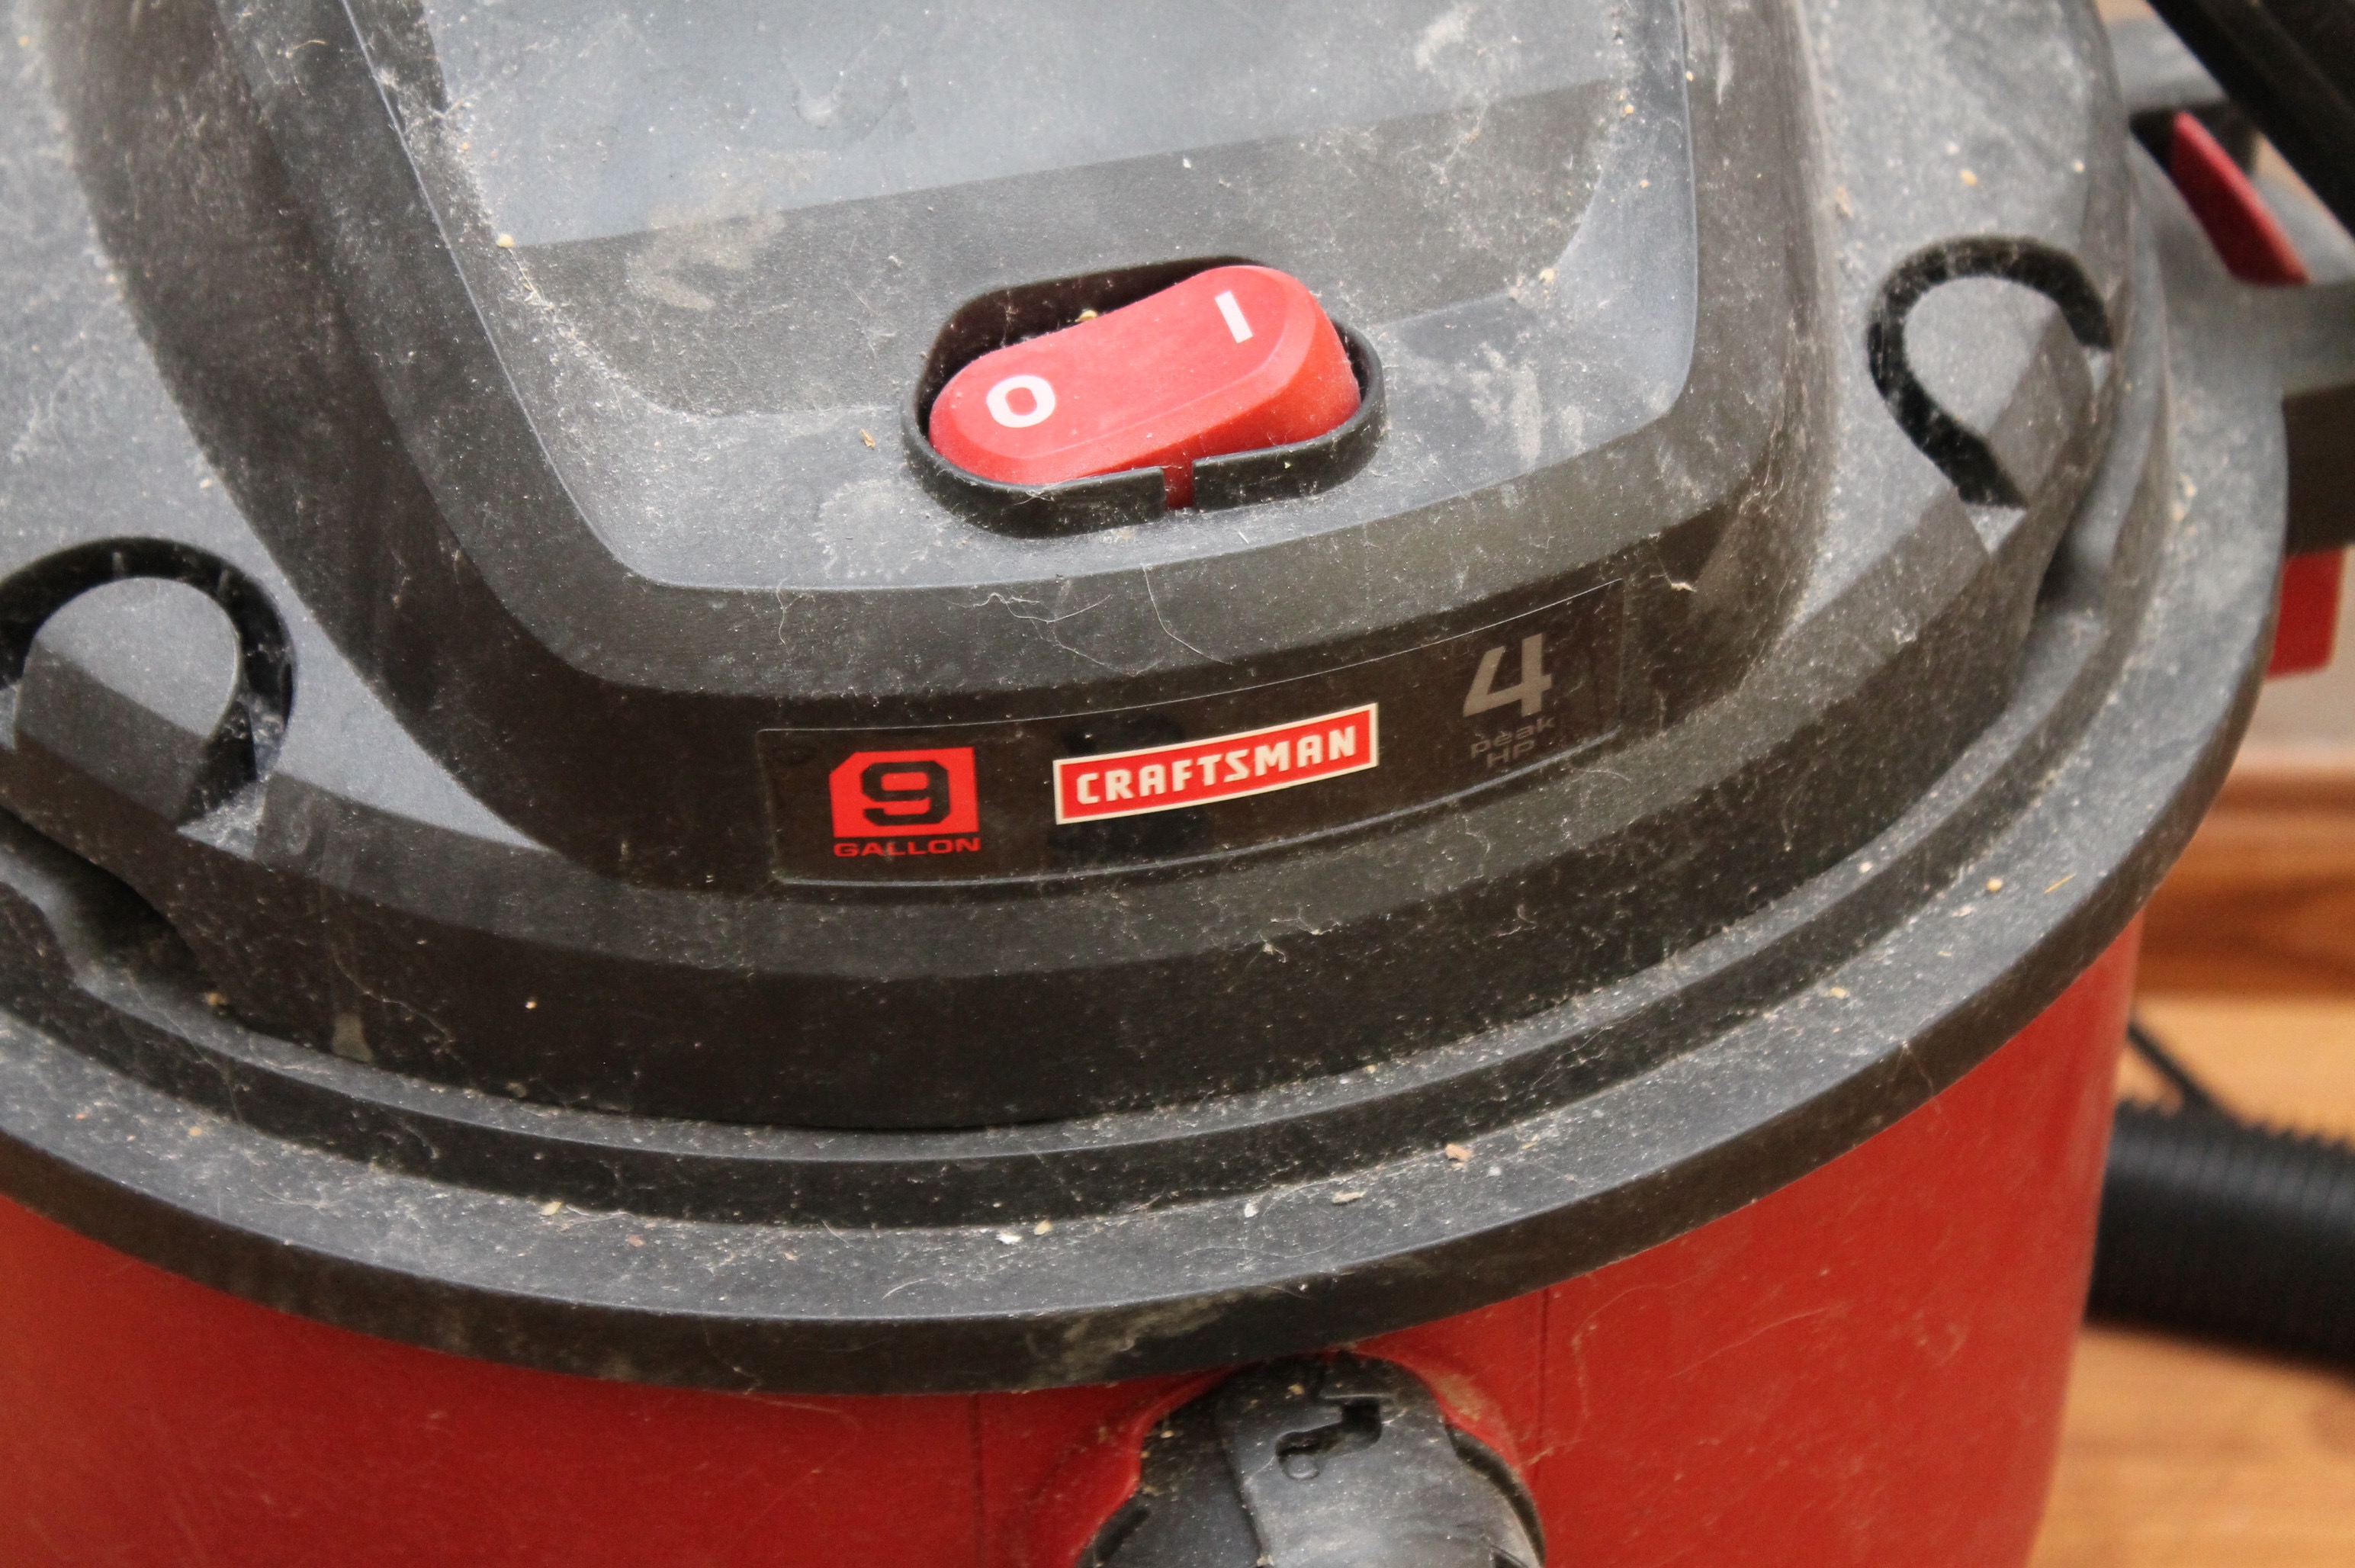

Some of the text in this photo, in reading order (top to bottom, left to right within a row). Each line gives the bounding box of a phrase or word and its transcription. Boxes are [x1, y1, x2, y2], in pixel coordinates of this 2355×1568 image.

[1463, 633, 1552, 718] 4
[1076, 725, 1357, 805] CRAFTSMAN
[1486, 738, 1535, 768] HP
[860, 760, 953, 826] 9
[833, 837, 981, 857] GALLON
